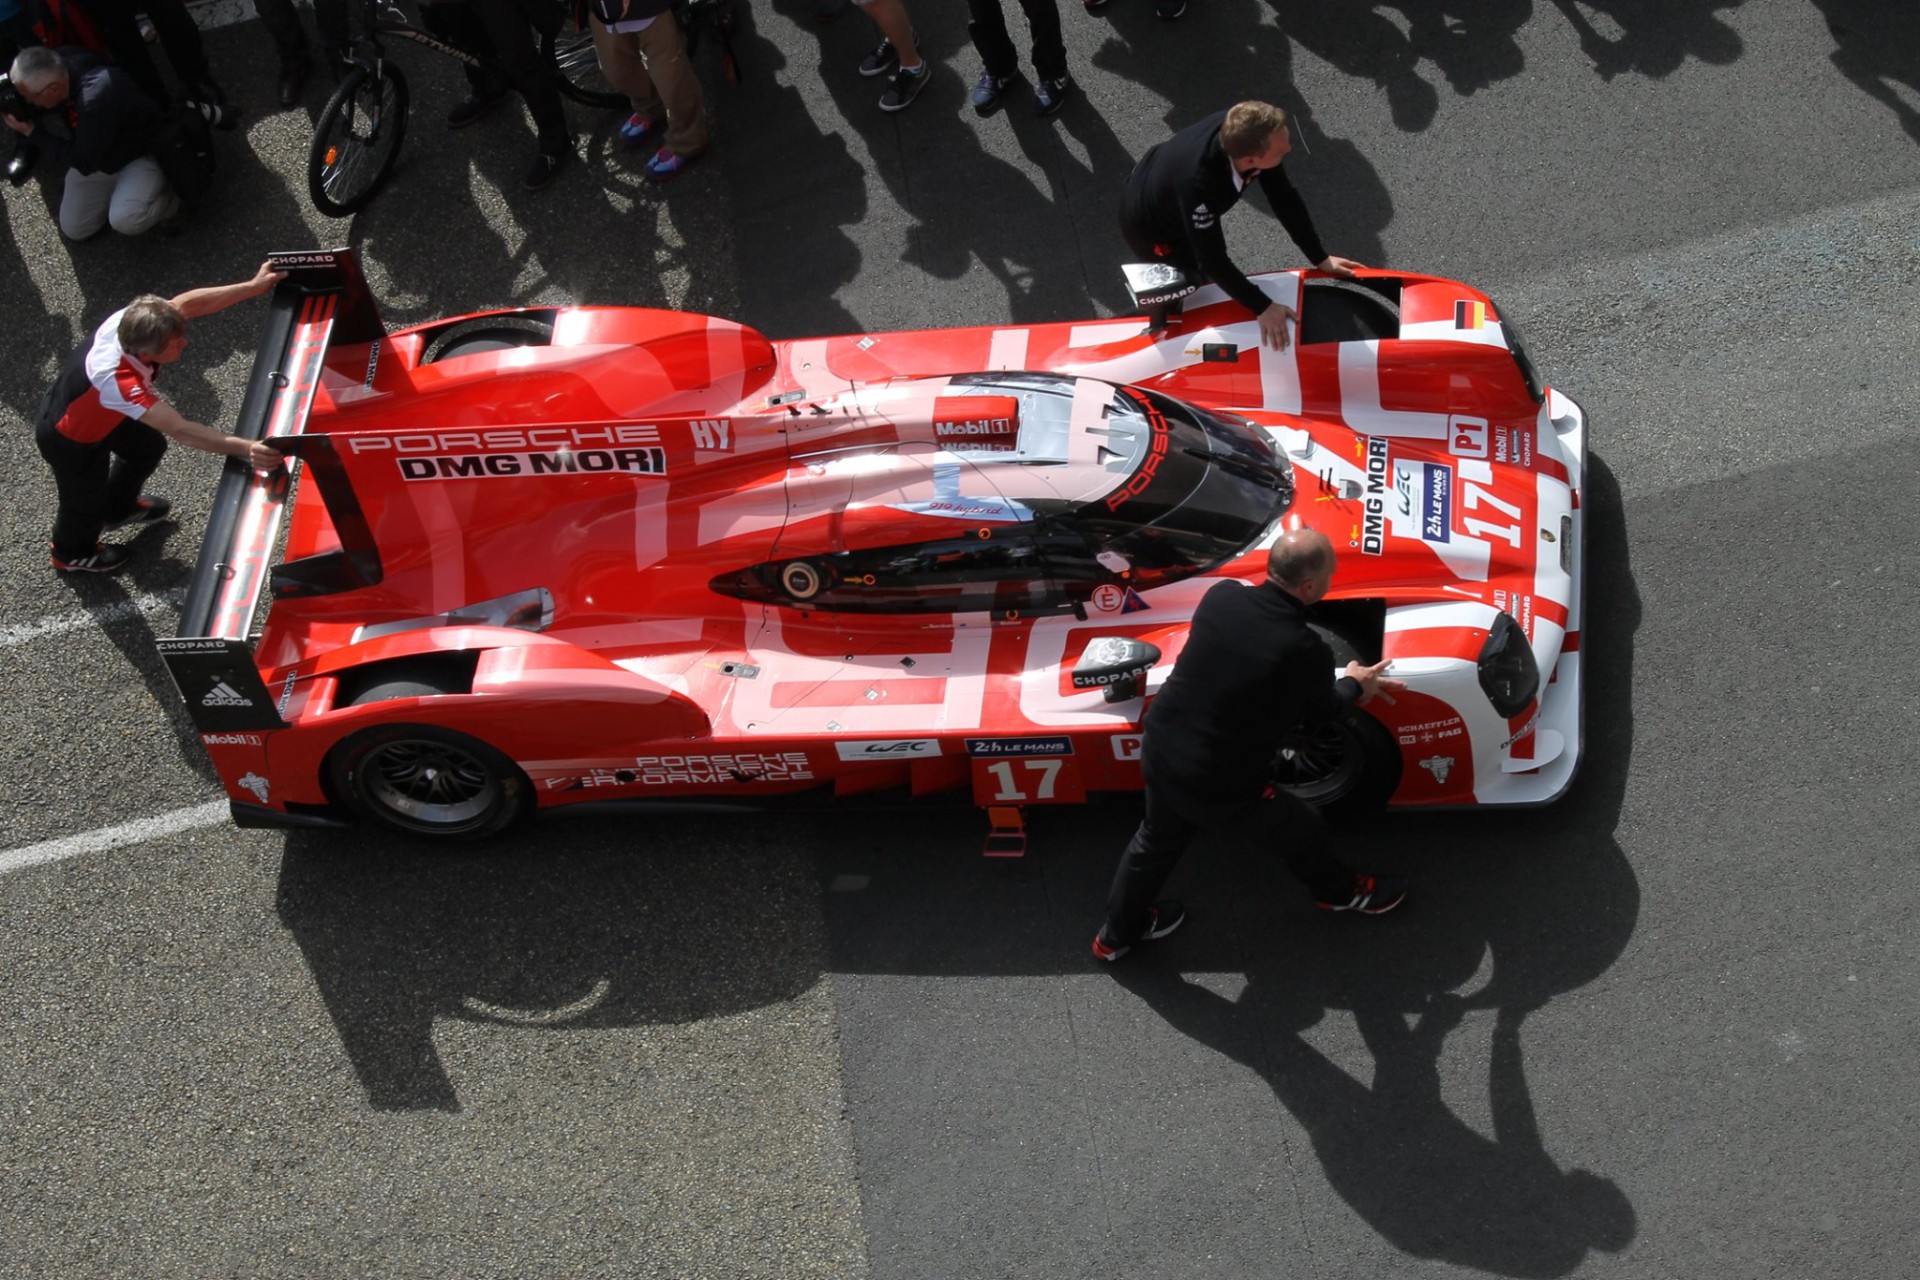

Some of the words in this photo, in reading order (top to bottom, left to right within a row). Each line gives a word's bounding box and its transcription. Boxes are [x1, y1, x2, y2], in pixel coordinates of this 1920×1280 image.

[272, 255, 334, 264] CHOPARD
[1139, 285, 1196, 305] CHOPARD
[689, 419, 730, 450] HY
[936, 420, 990, 435] Mobil
[991, 418, 1010, 434] 1
[349, 424, 660, 455] PORSCHE
[1455, 423, 1483, 451] P1
[1106, 386, 1169, 512] PORSCHE
[1495, 435, 1507, 462] Mobil
[402, 455, 521, 480] DMG
[533, 448, 664, 474] MORI
[1368, 436, 1386, 494] MORI
[1397, 467, 1411, 517] WEC
[1433, 469, 1443, 501] MANS
[929, 502, 953, 510] 919
[1432, 500, 1442, 515] LE
[1463, 482, 1522, 549] 17
[1364, 499, 1383, 554] DMG
[159, 641, 226, 650] CHOPARD
[1074, 663, 1154, 685] CHOPARD
[202, 696, 253, 706] adidas
[1398, 717, 1460, 733] SCHAEFFLER
[1439, 727, 1462, 738] FAG
[204, 735, 246, 744] Mobil
[246, 735, 262, 745] 1
[865, 741, 927, 753] WEC
[1024, 742, 1064, 751] MANS
[1122, 736, 1142, 758] P
[590, 761, 809, 776] INTELLIGENT
[636, 752, 807, 767] PORSCHE
[545, 771, 814, 789] PERORMACE
[988, 760, 1063, 801] 17
